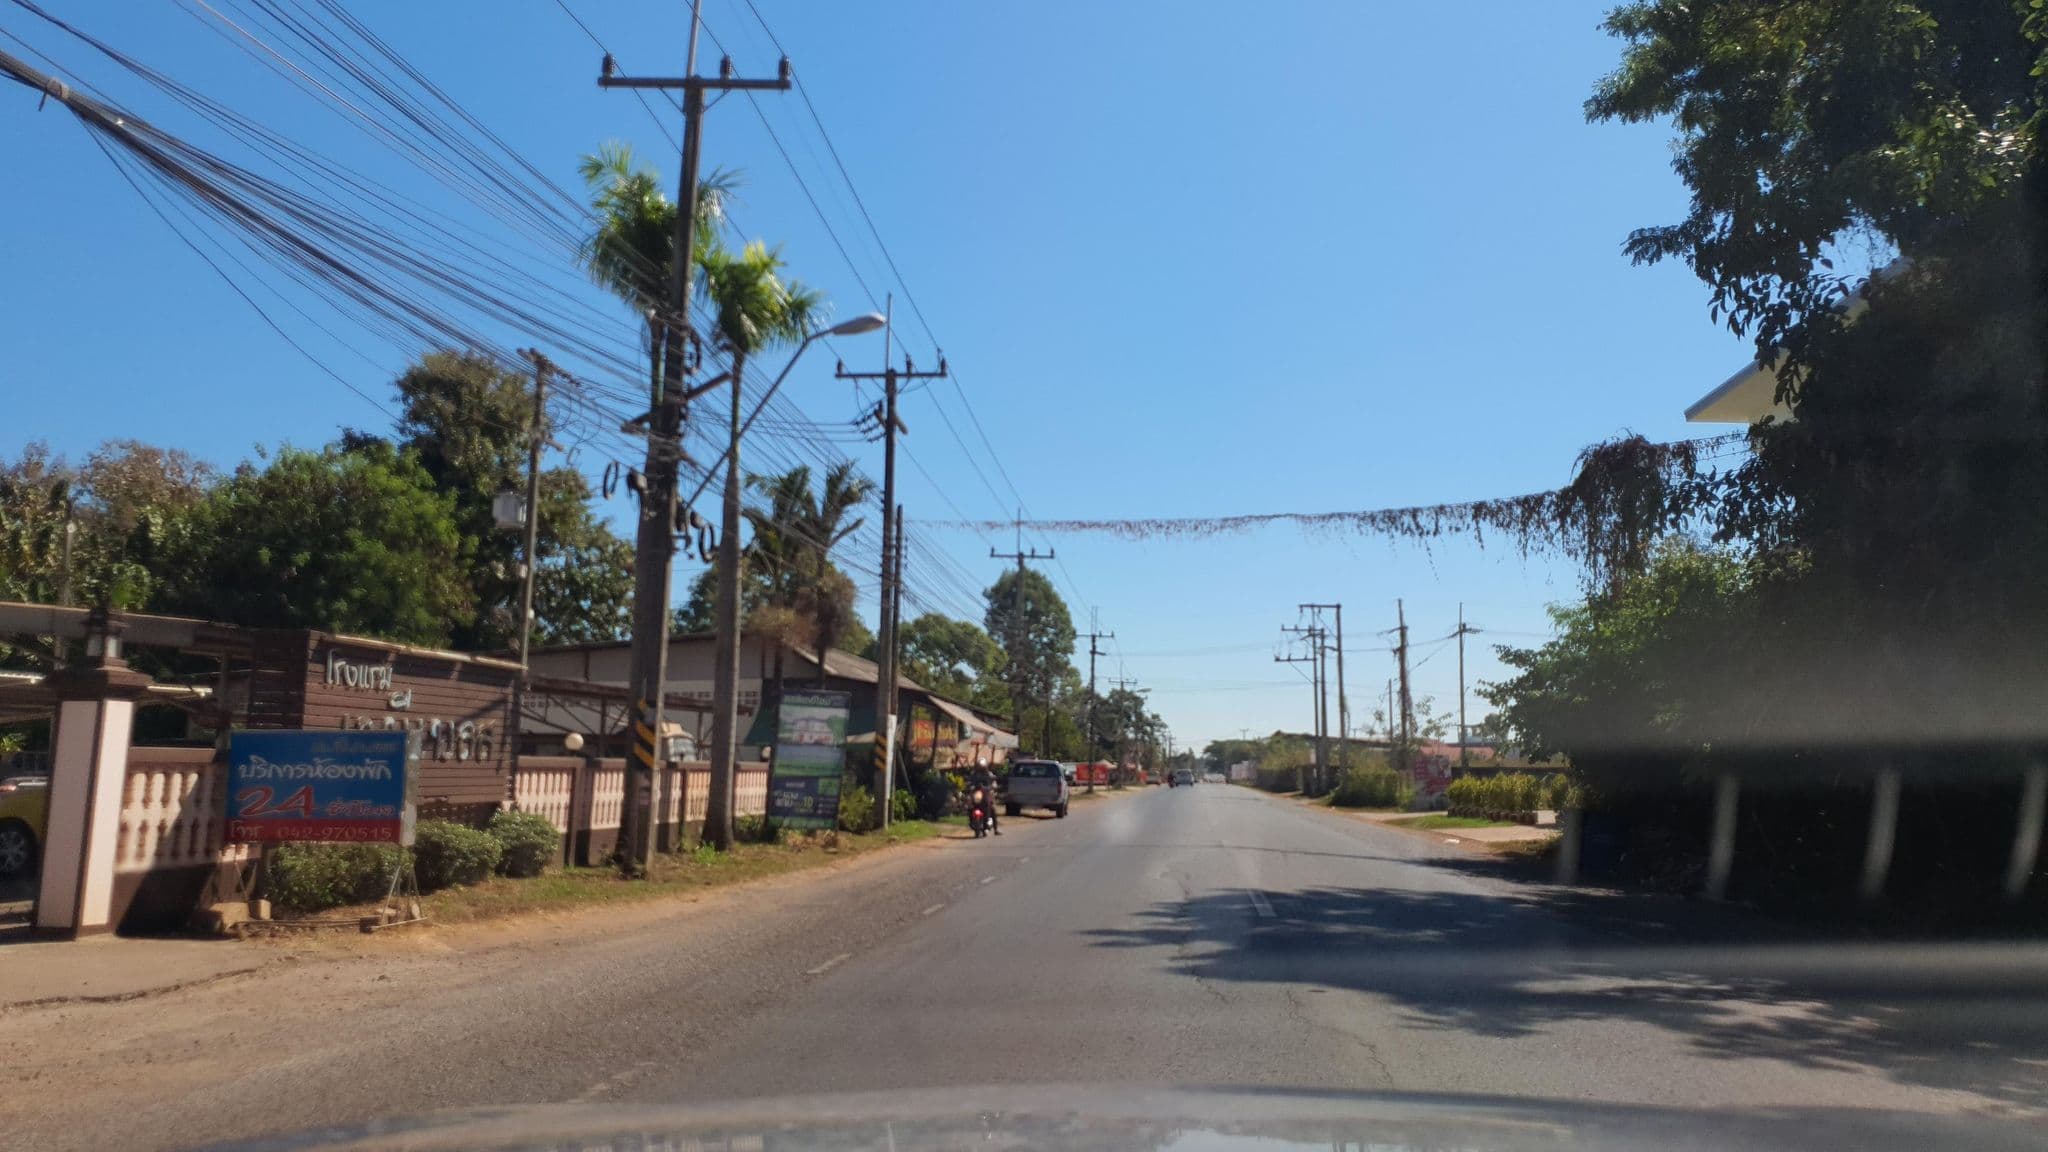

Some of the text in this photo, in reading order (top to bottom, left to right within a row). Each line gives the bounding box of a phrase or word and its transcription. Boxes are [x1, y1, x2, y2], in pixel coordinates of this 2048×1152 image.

[327, 648, 393, 690] โรงแรม
[238, 755, 393, 780] บริการห้องพัก
[237, 784, 315, 817] 24
